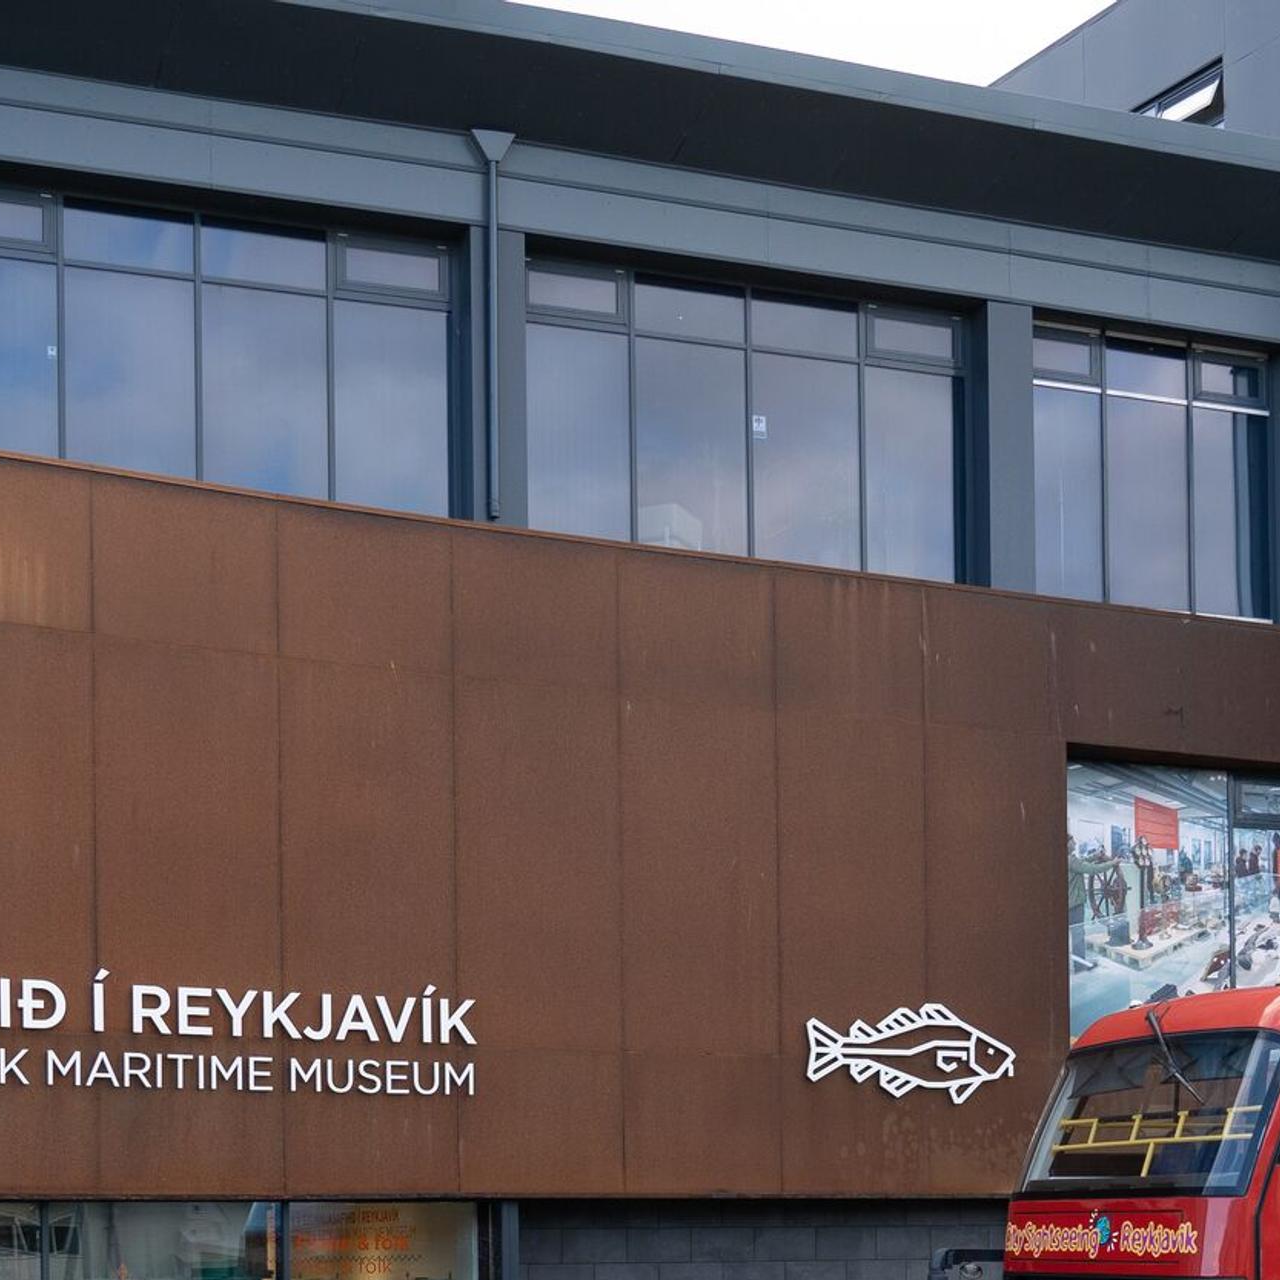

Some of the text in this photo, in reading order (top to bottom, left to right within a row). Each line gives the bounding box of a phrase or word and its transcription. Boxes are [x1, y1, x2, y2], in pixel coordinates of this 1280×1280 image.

[94, 969, 110, 1032] Í
[132, 985, 477, 1045] REYKJAVÍK
[47, 1050, 274, 1091] MARITIME
[290, 1058, 474, 1096] MUSEUM
[1120, 1220, 1198, 1257] Reykjavik
